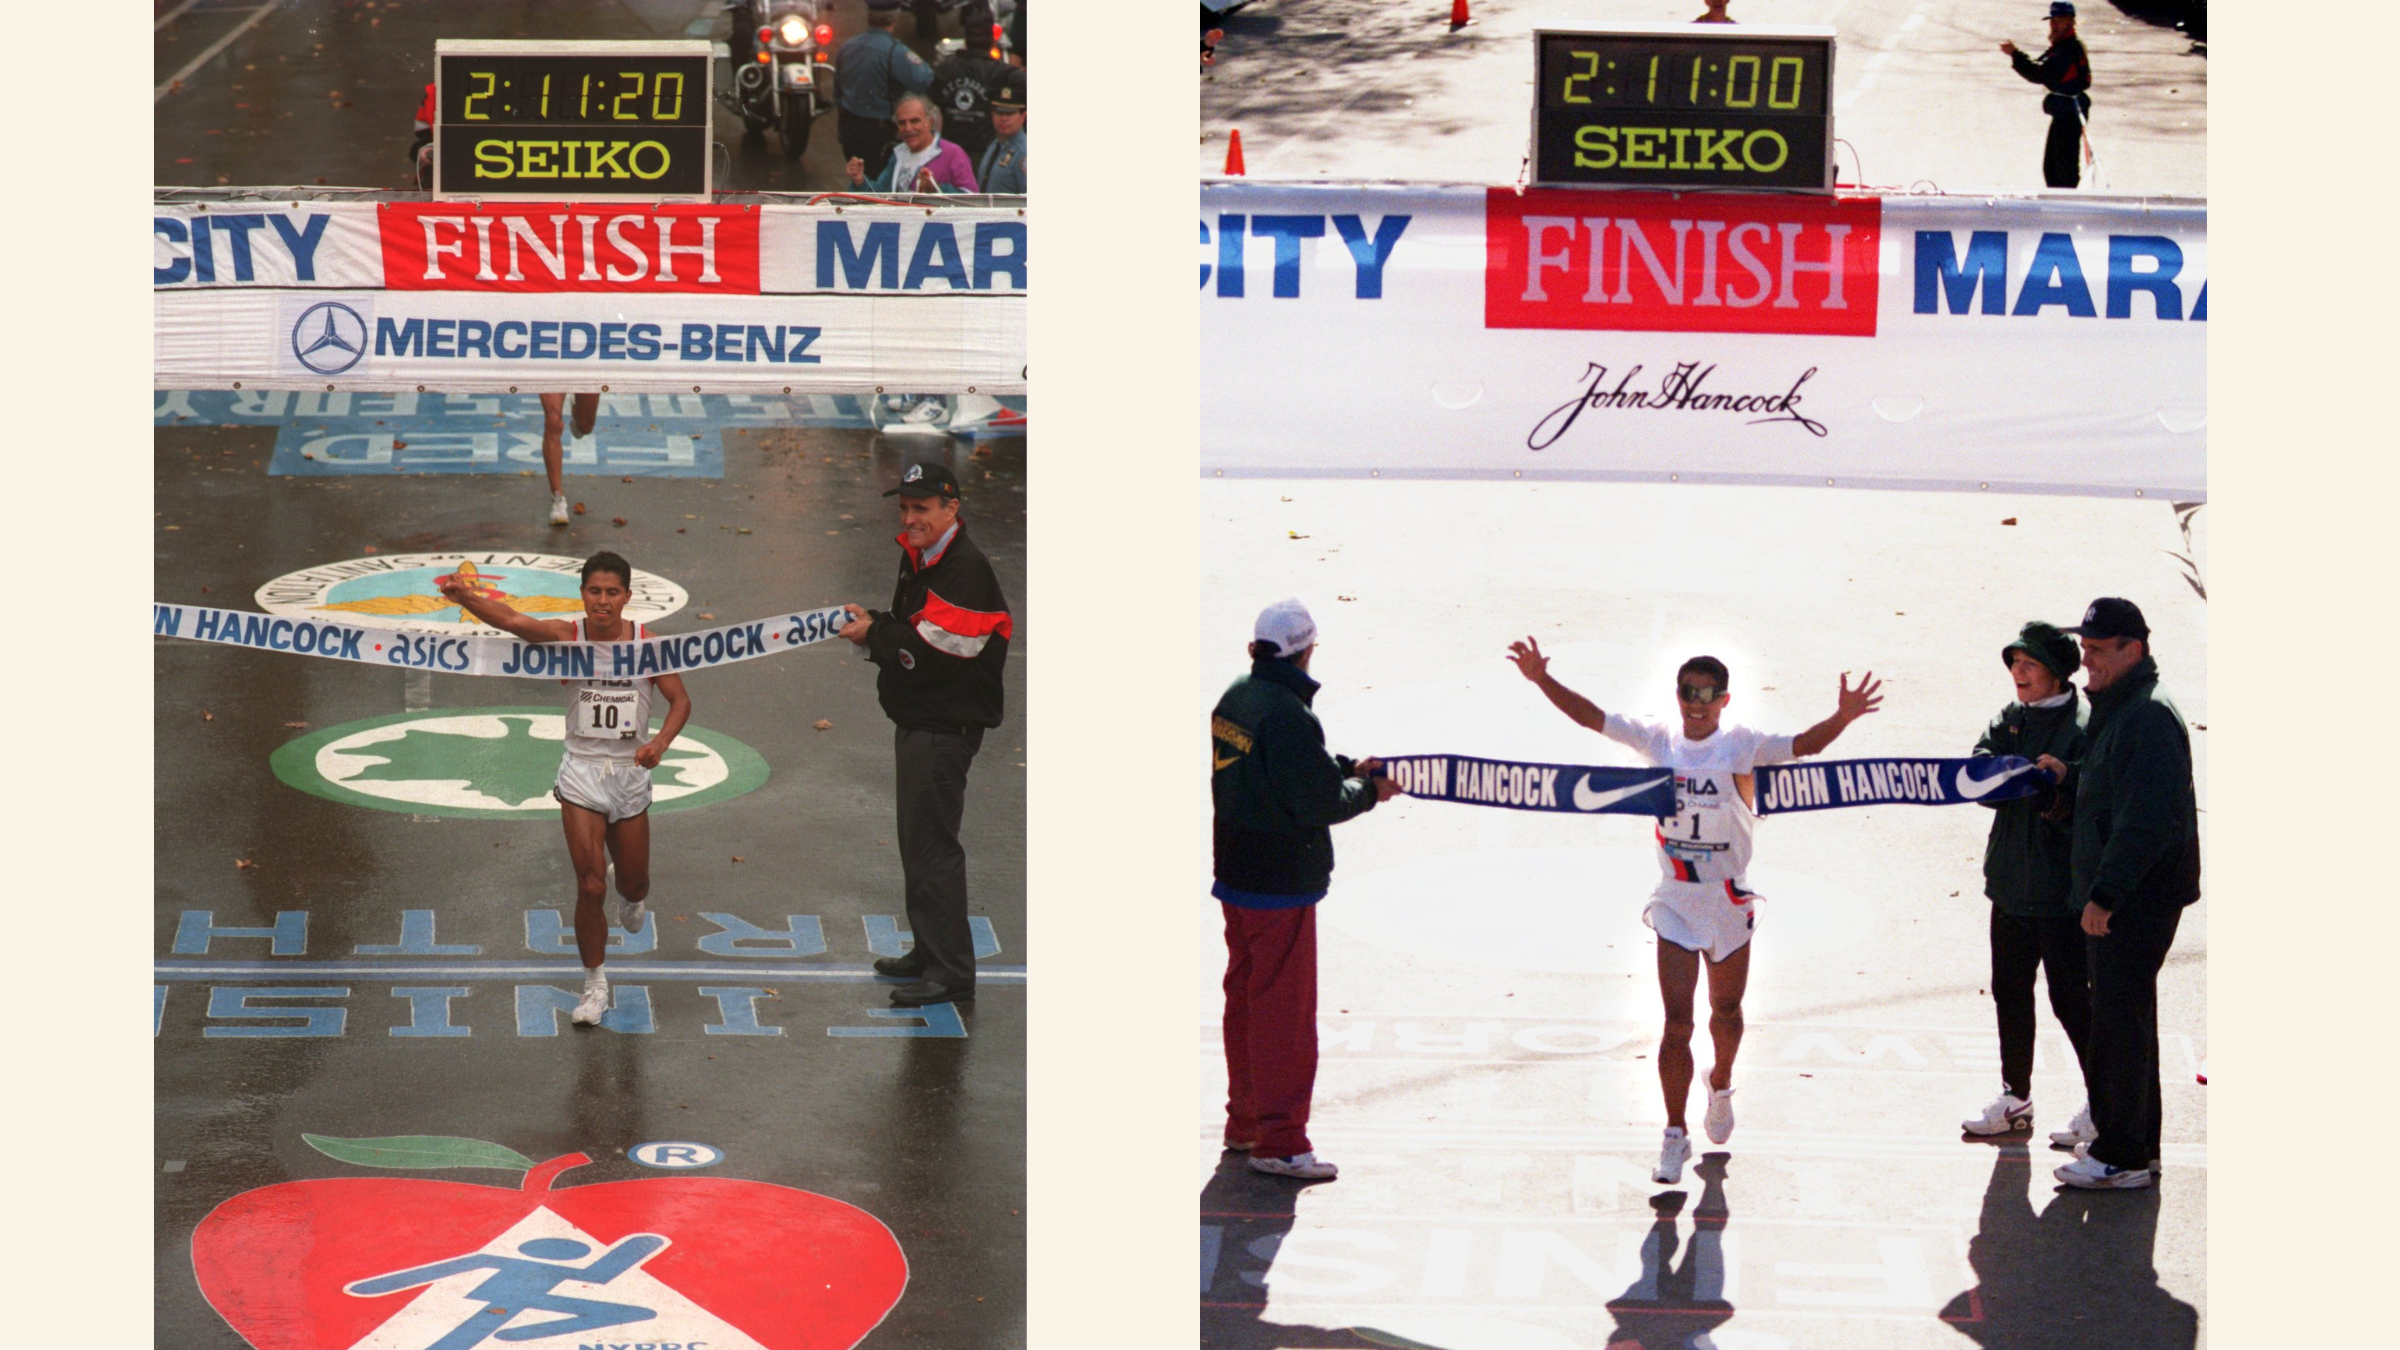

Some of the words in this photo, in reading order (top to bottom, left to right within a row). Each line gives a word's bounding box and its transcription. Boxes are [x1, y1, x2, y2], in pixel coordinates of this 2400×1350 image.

[464, 72, 684, 120] 2:11:20
[1563, 51, 1803, 110] 2:11:00
[474, 140, 671, 180] SEIKO
[1574, 125, 1789, 173] SEIKO
[417, 213, 722, 284] FINISH
[1200, 214, 1413, 299] ITY
[1521, 215, 1852, 310] FINISH
[1913, 230, 2207, 322] MAR
[375, 317, 822, 364] MERCEDES-BENZ
[1528, 362, 1651, 450] John
[1649, 361, 1828, 438] Hancock
[265, 556, 426, 605] SANITATION
[195, 609, 365, 660] HANCOCK
[387, 633, 470, 671] asics
[502, 642, 595, 678] JOHN
[612, 623, 767, 677] HANCOCK
[592, 704, 618, 729] 10
[1455, 760, 1559, 807] HANCOCK
[1764, 767, 1830, 810] JOHN
[1835, 762, 1946, 803] HANCOCK
[1676, 776, 1719, 795] FILA
[1690, 813, 1701, 840] 1
[154, 985, 968, 1038] FINIS
[1200, 1226, 1937, 1308] FINIS
